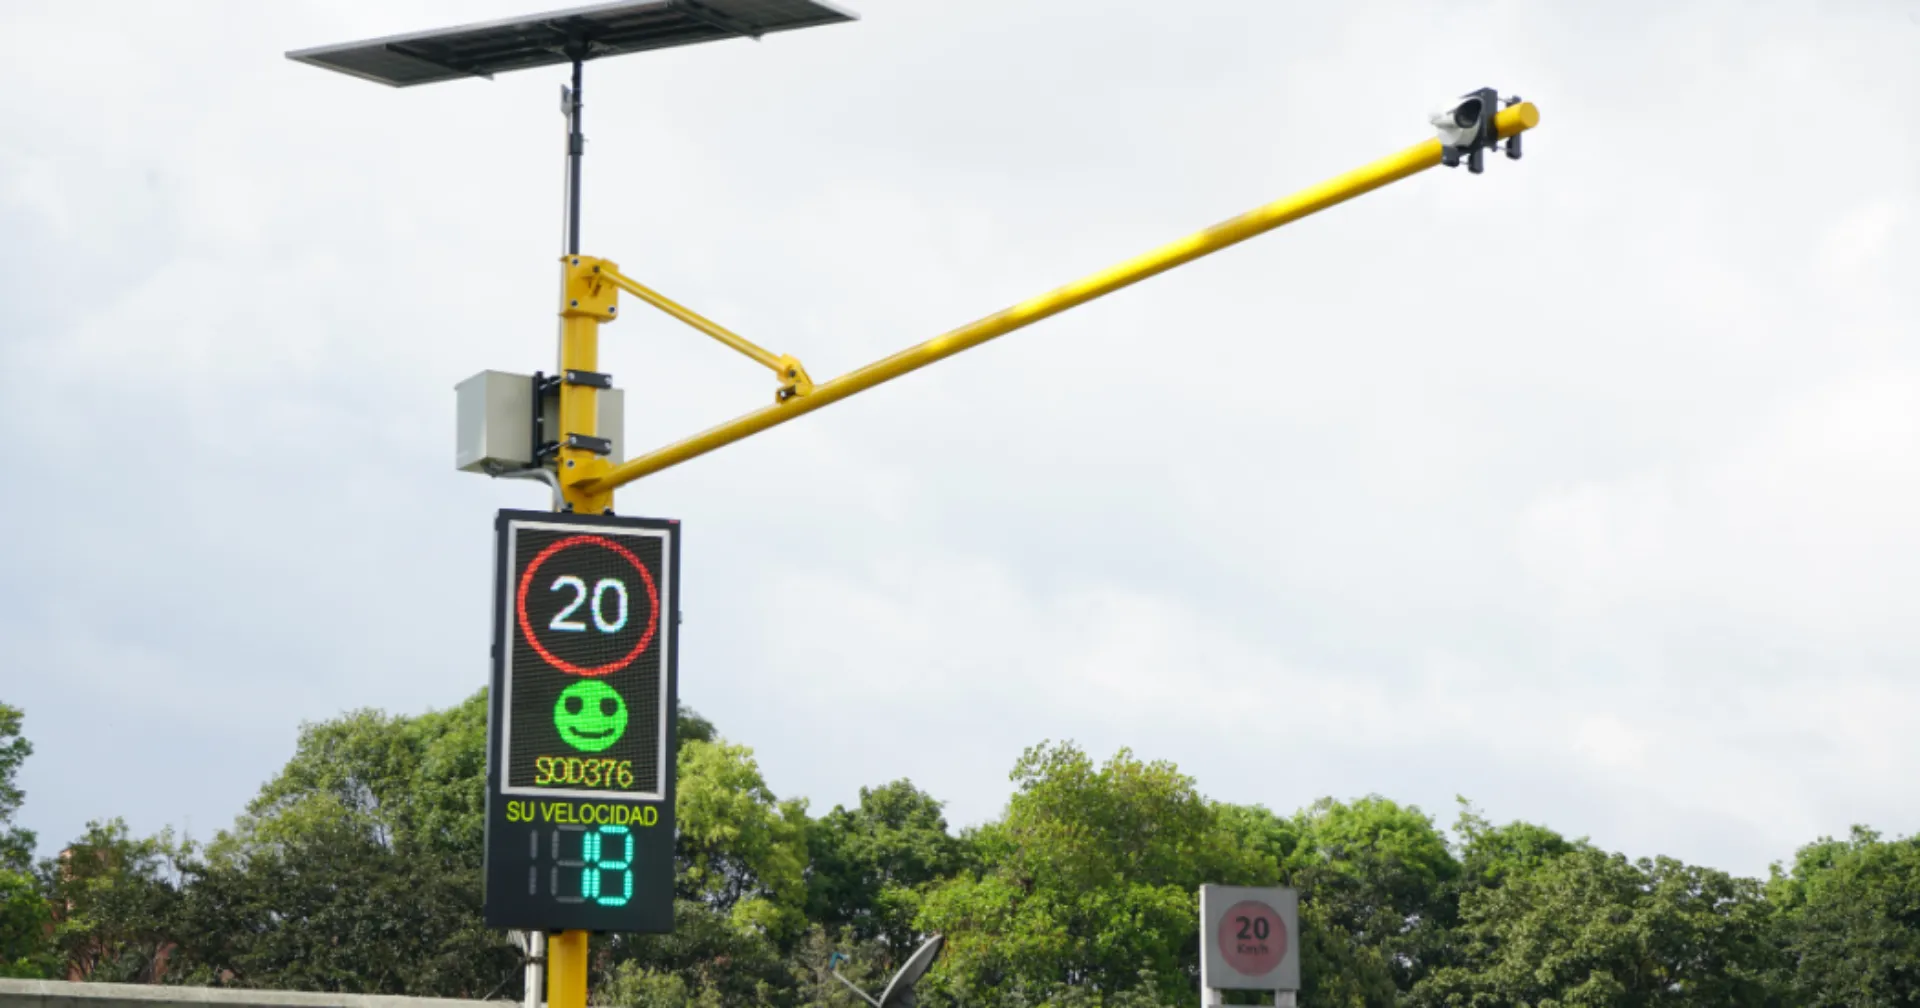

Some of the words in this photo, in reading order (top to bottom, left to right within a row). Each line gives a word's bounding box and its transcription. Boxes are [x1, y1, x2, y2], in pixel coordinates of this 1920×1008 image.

[549, 575, 628, 633] 20
[535, 756, 634, 788] SOD376
[506, 801, 535, 822] SU
[540, 802, 658, 826] VELOCIDAD
[1236, 916, 1270, 940] 20
